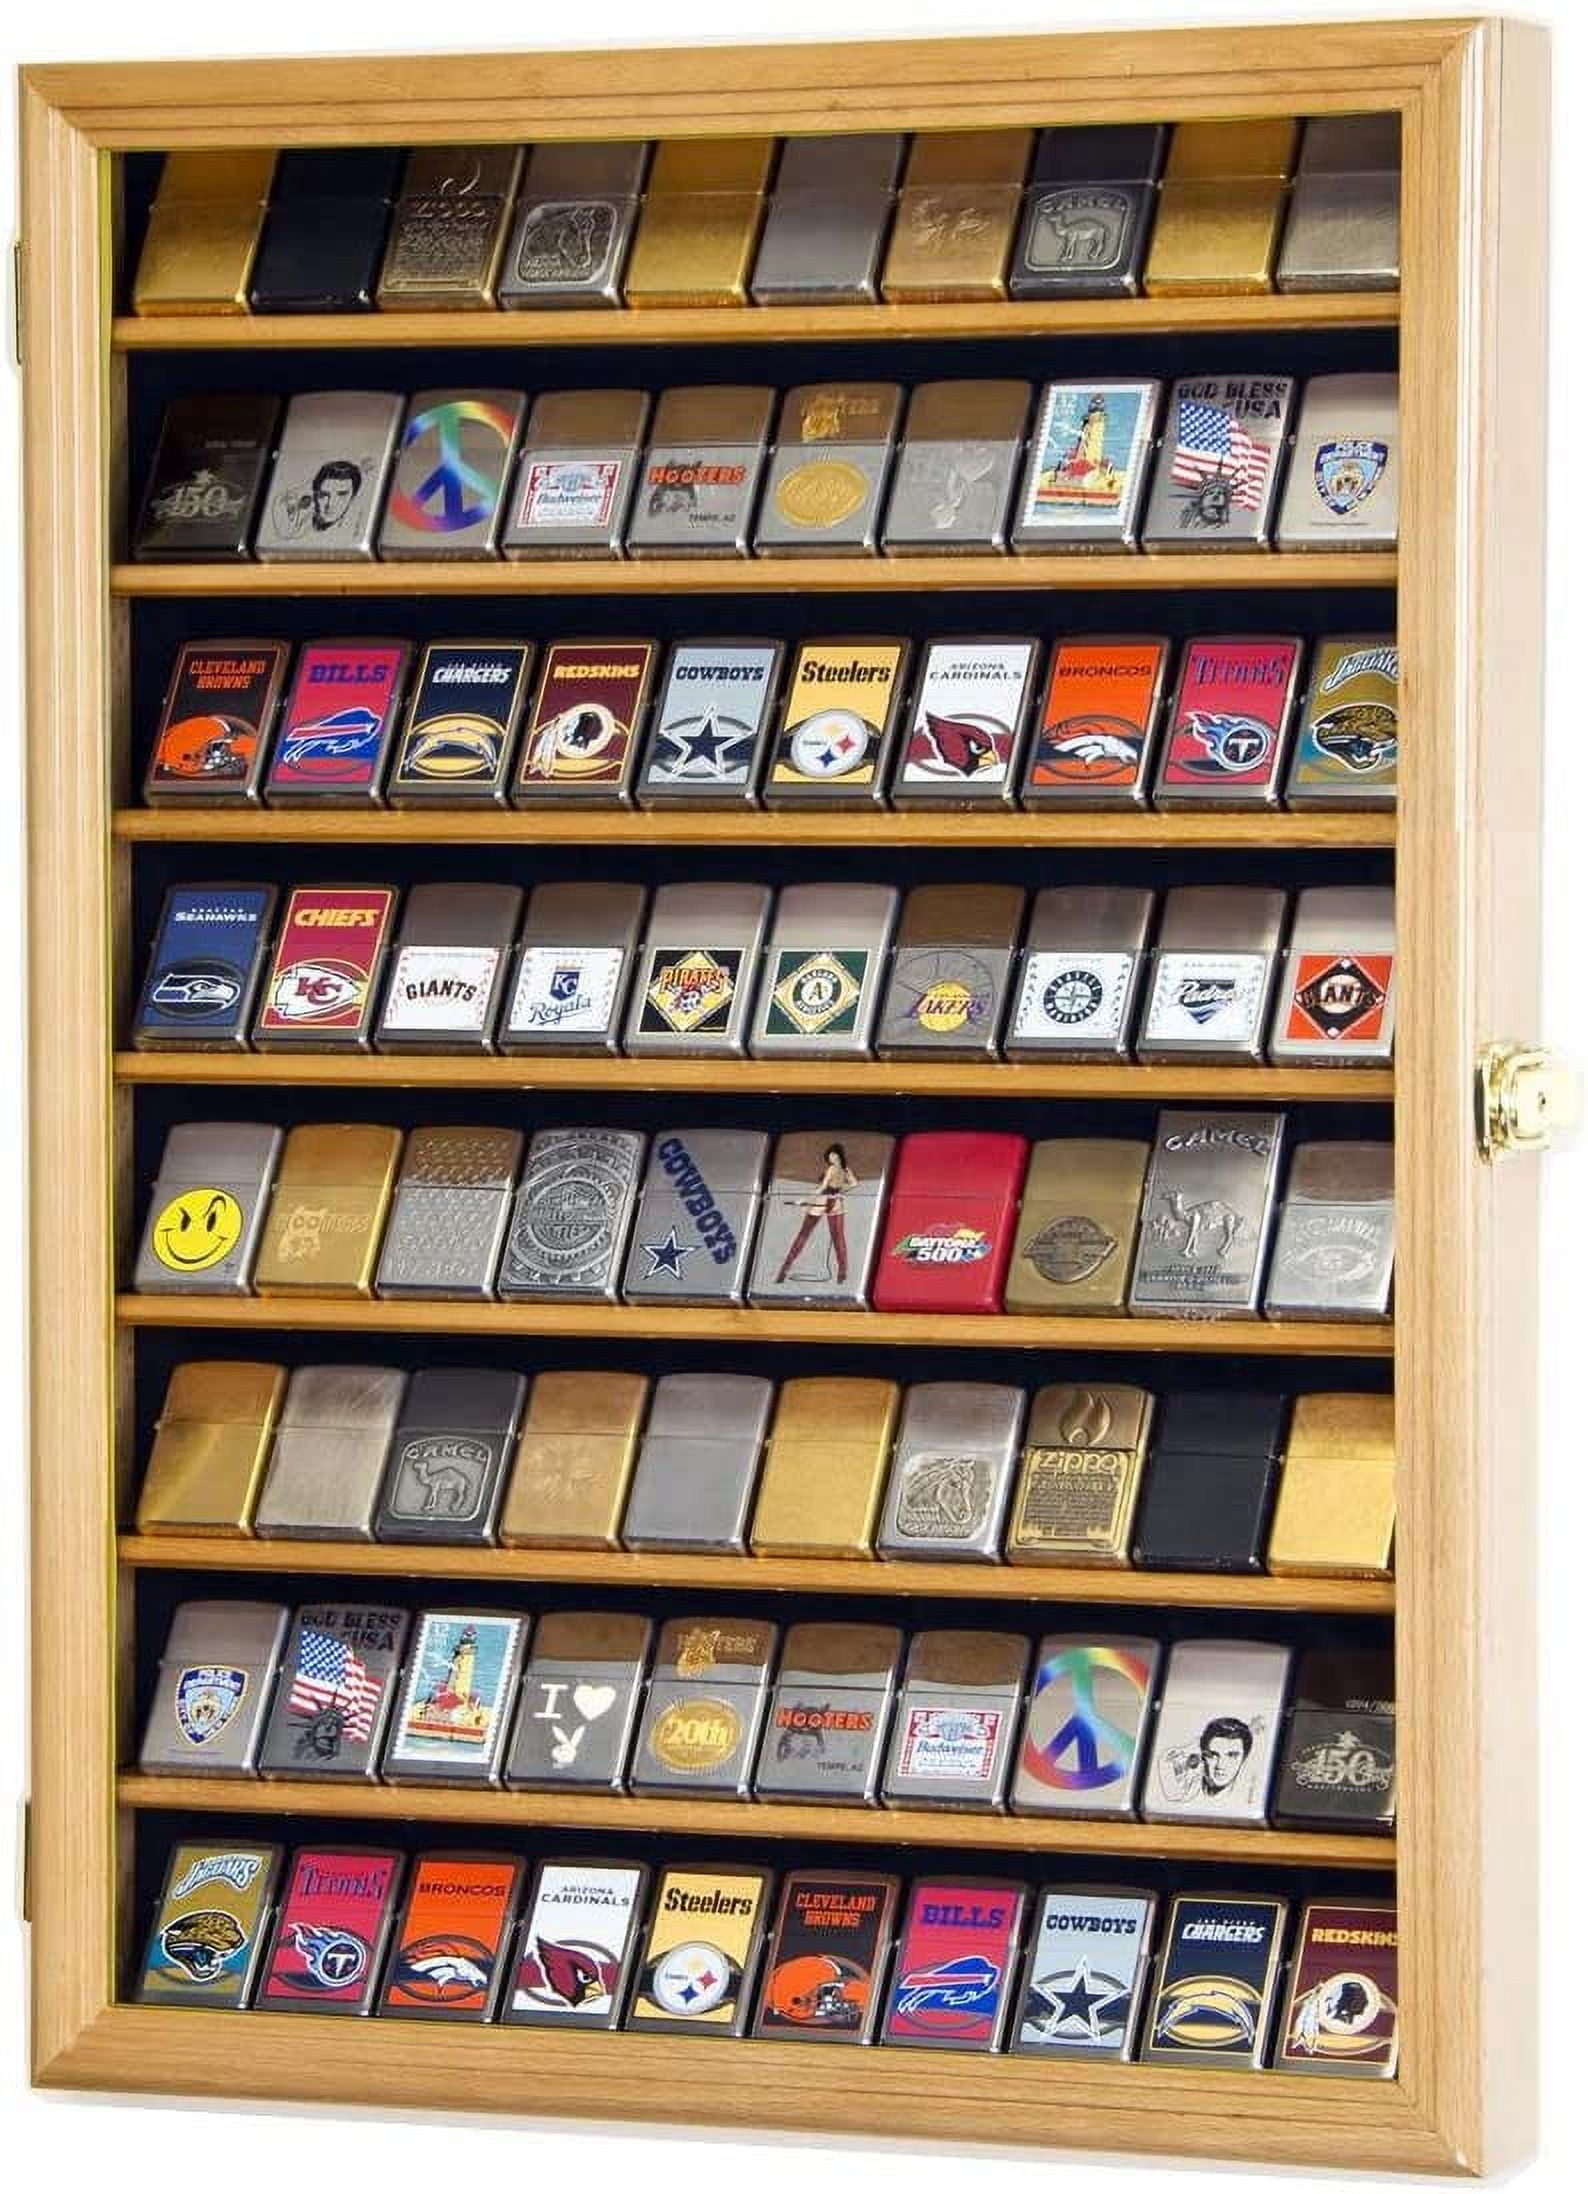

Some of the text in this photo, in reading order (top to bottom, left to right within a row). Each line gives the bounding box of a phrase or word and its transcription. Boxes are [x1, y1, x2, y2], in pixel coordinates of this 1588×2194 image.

[1226, 381, 1288, 398] BLESS
[190, 660, 266, 675] CLEVELAND
[309, 664, 388, 683] BILLS
[432, 667, 512, 684] CHARGERS
[553, 665, 640, 680] REDSKINS
[676, 665, 764, 681] COWBOYS
[801, 661, 891, 682] Steelers
[929, 671, 1022, 680] CARDINALS
[951, 662, 1005, 671] ARIZONA
[1059, 664, 1152, 678] BRONCOS
[196, 675, 251, 689] BROWNS
[174, 911, 258, 922] SEAHAWKS
[295, 908, 380, 927] CHIEFS
[405, 978, 478, 1001] GIANTS
[554, 973, 578, 995] KC
[660, 967, 726, 993] PIRATES
[296, 976, 343, 1005] KC
[527, 995, 592, 1025] Royals
[657, 1137, 738, 1265] COWBOYS
[909, 1236, 978, 1249] DAYTONA
[916, 1248, 963, 1262] 500
[405, 1441, 489, 1462] CAMEL
[344, 1611, 400, 1630] BLESS
[533, 1683, 569, 1719] I
[777, 1708, 874, 1731] HOOTERS
[417, 1882, 508, 1898] BRONCOS
[560, 1886, 614, 1896] ARIZONA
[541, 1893, 631, 1907] CARDINALS
[664, 1886, 753, 1917] Steelers
[796, 1893, 877, 1912] CLEVELAND
[804, 1910, 861, 1929] BROWNS
[922, 1904, 1004, 1929] BILLS
[1046, 1914, 1138, 1935] COWBOYS
[1181, 1922, 1266, 1944] CHARGERS
